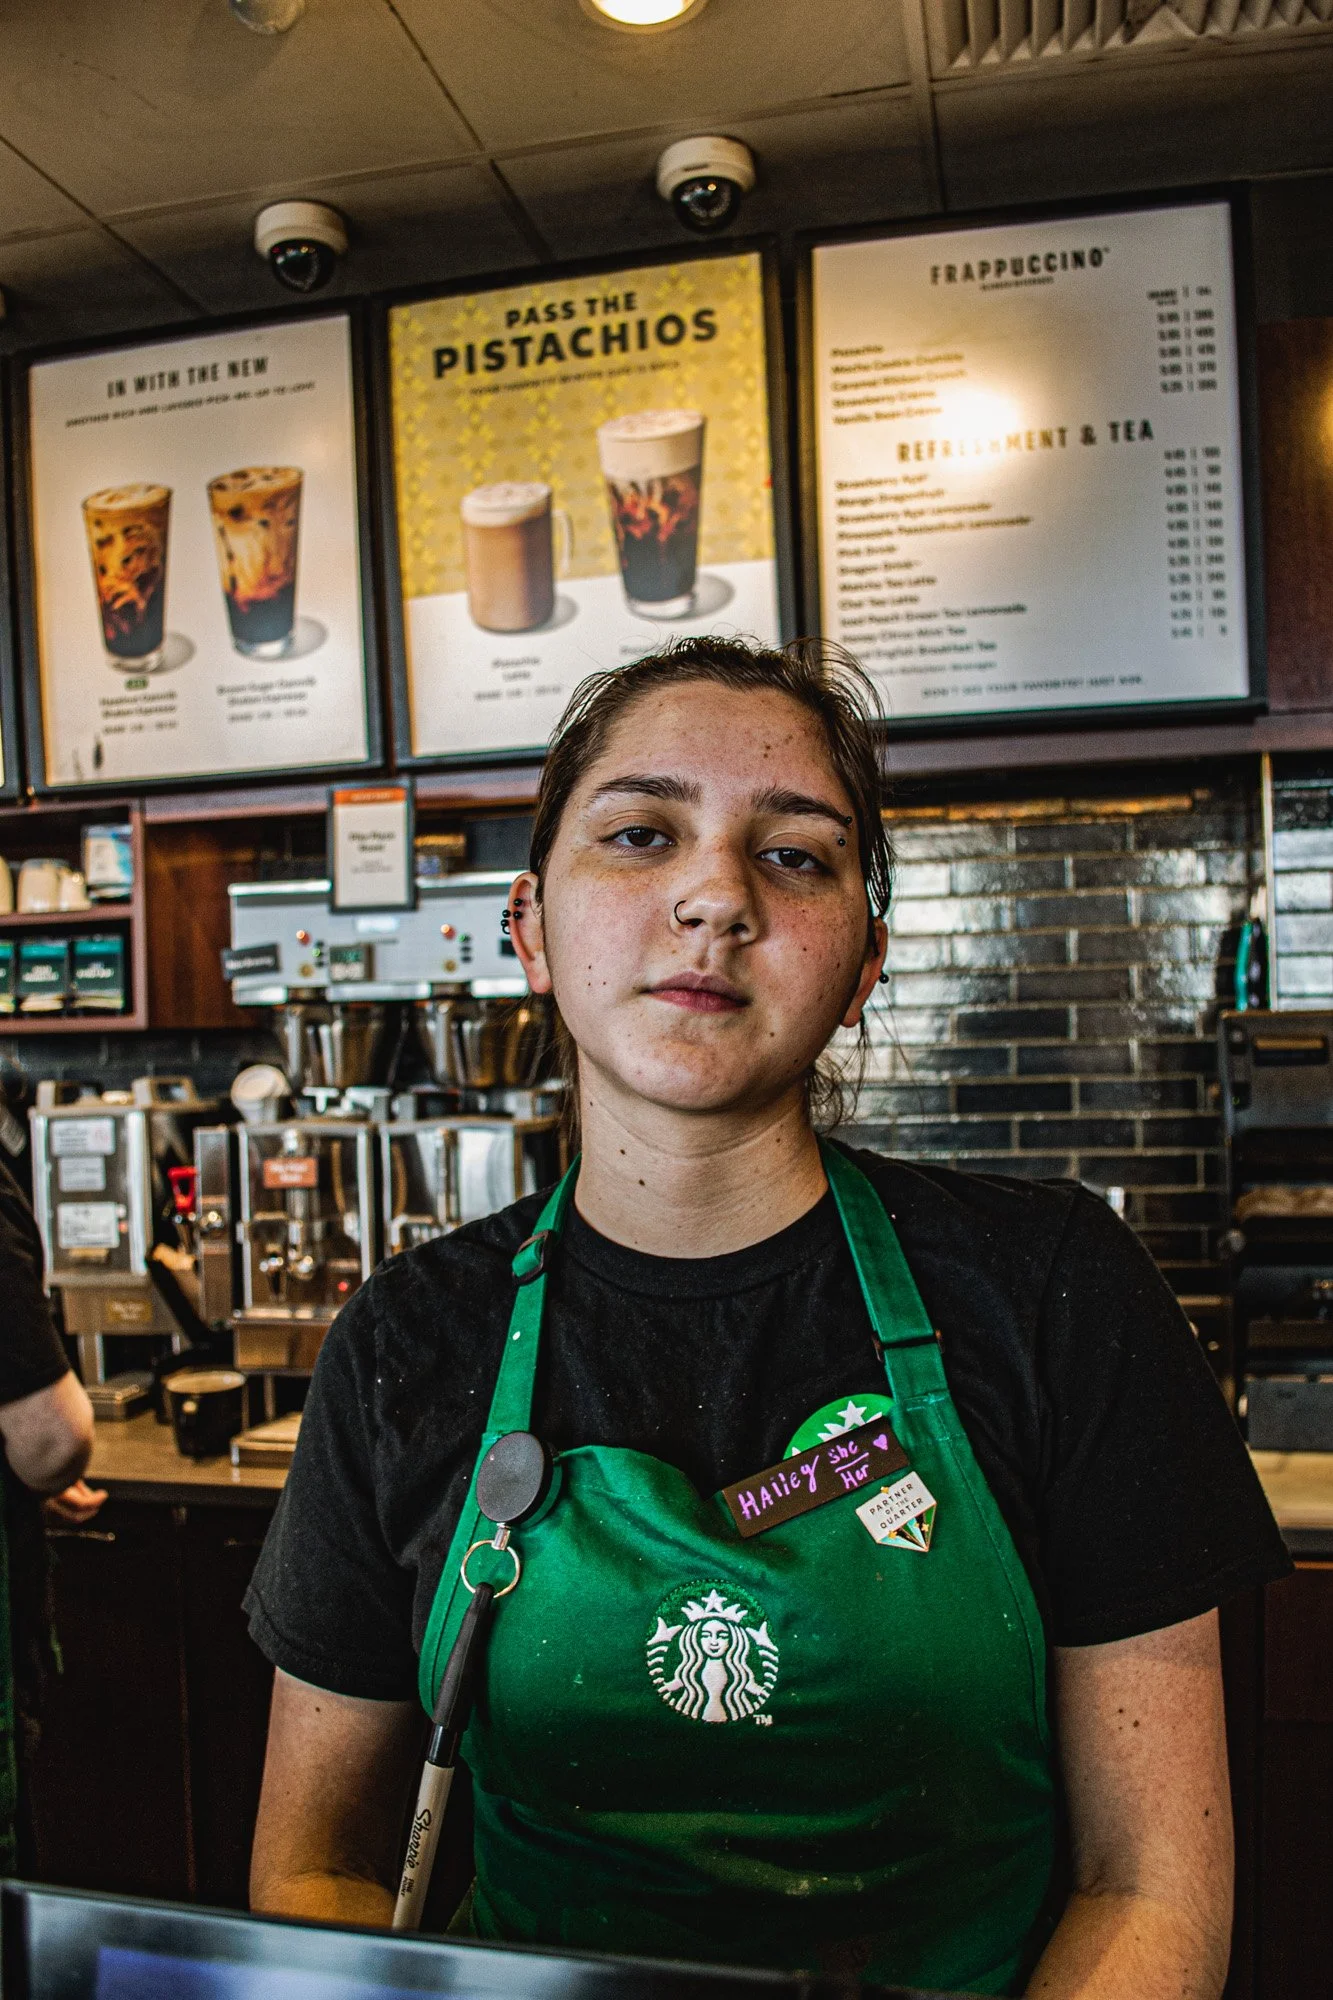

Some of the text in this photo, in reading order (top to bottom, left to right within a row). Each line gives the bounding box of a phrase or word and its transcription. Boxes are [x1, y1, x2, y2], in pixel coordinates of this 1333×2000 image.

[506, 291, 637, 328] PASS THE
[433, 308, 718, 379] PISTACHIOS
[107, 356, 269, 399] IN WITH THE NEW
[1080, 424, 1098, 447] &
[1109, 419, 1155, 443] TEA
[869, 1483, 914, 1516] PARTNER
[880, 1497, 924, 1529] QUARTER
[885, 1497, 909, 1515] OF THE
[405, 1808, 432, 1870] Sharpie
